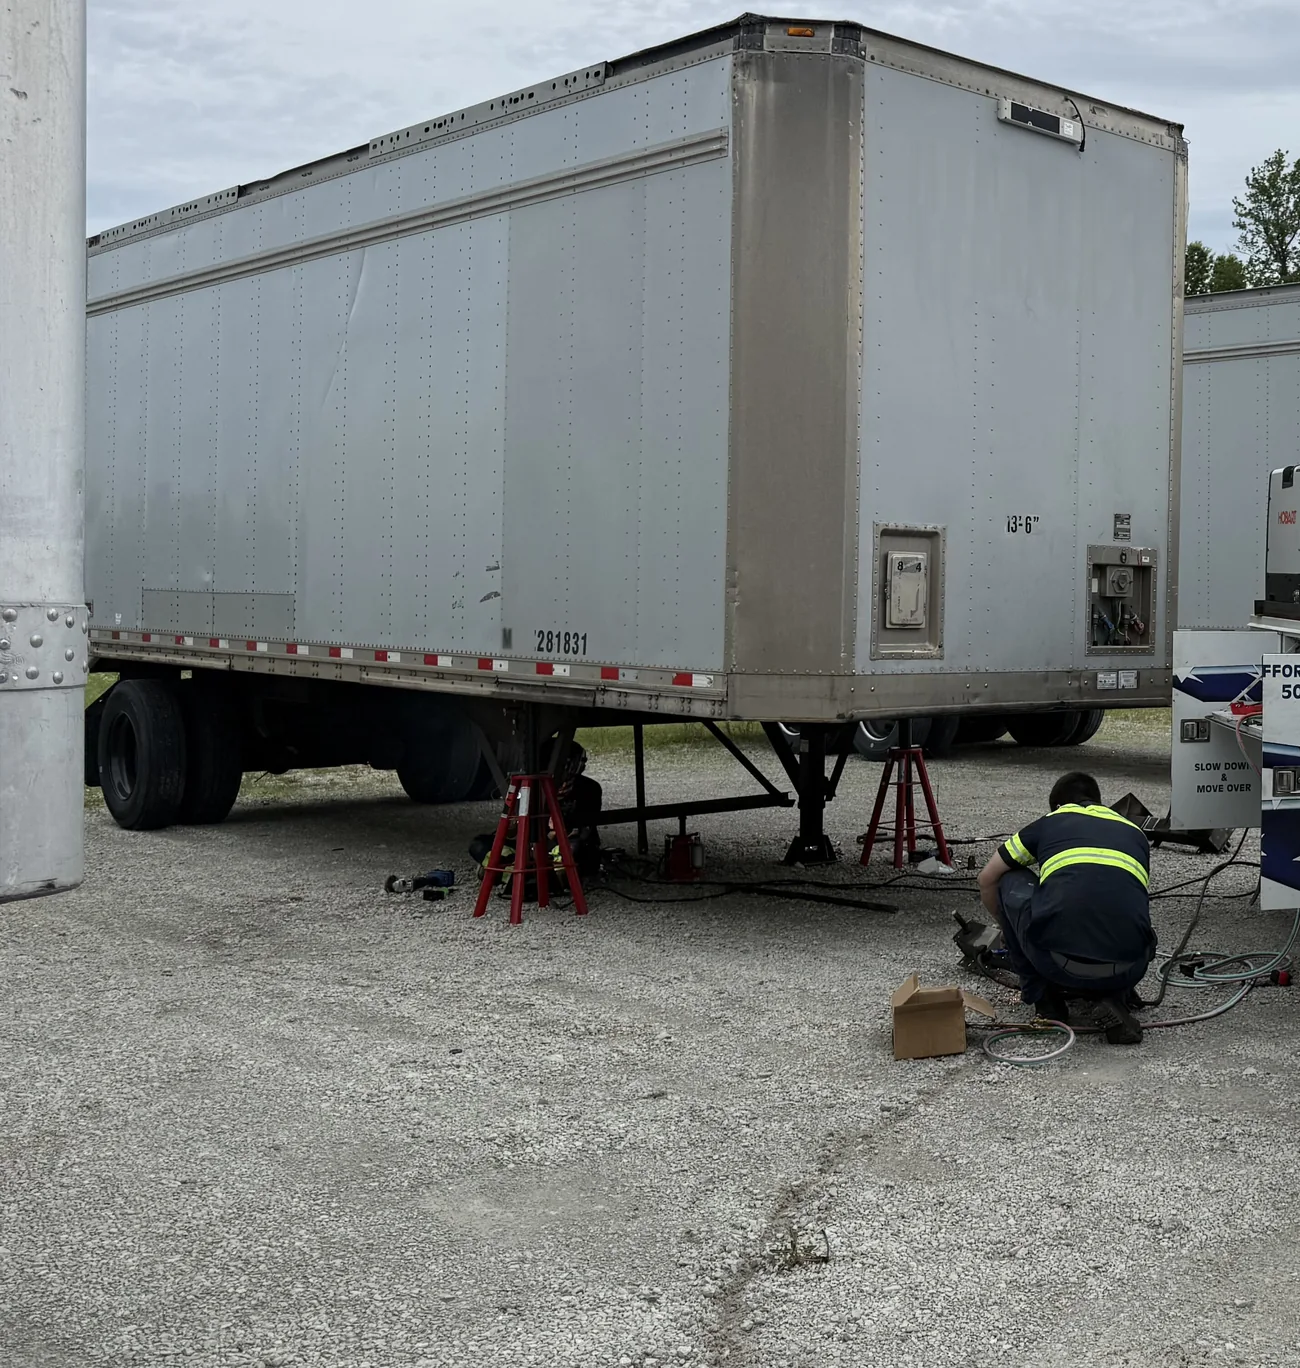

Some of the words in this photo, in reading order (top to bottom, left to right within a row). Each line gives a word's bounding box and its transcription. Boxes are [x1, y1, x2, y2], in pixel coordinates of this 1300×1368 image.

[897, 561, 904, 571] 8
[915, 562, 922, 572] 4
[537, 629, 587, 656] 281831
[1194, 762, 1221, 772] SLOW
[1221, 773, 1228, 782] &
[1196, 784, 1224, 793] MOVE
[1226, 783, 1252, 792] OVER
